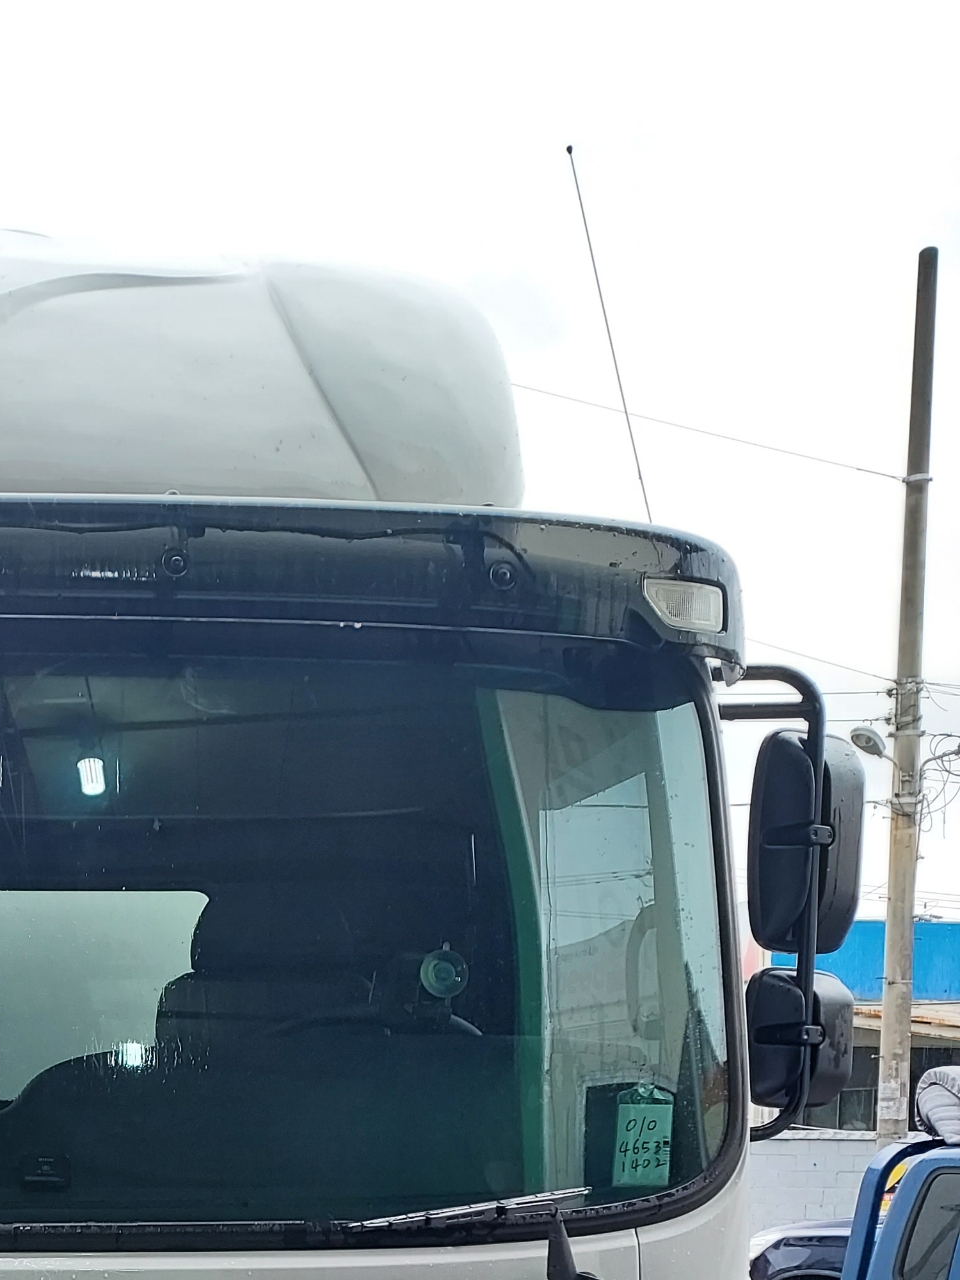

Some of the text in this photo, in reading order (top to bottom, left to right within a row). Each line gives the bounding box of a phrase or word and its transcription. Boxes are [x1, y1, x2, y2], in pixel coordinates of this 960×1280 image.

[625, 1116, 657, 1138] 010
[619, 1139, 662, 1158] 4653
[622, 1157, 667, 1173] 1402
